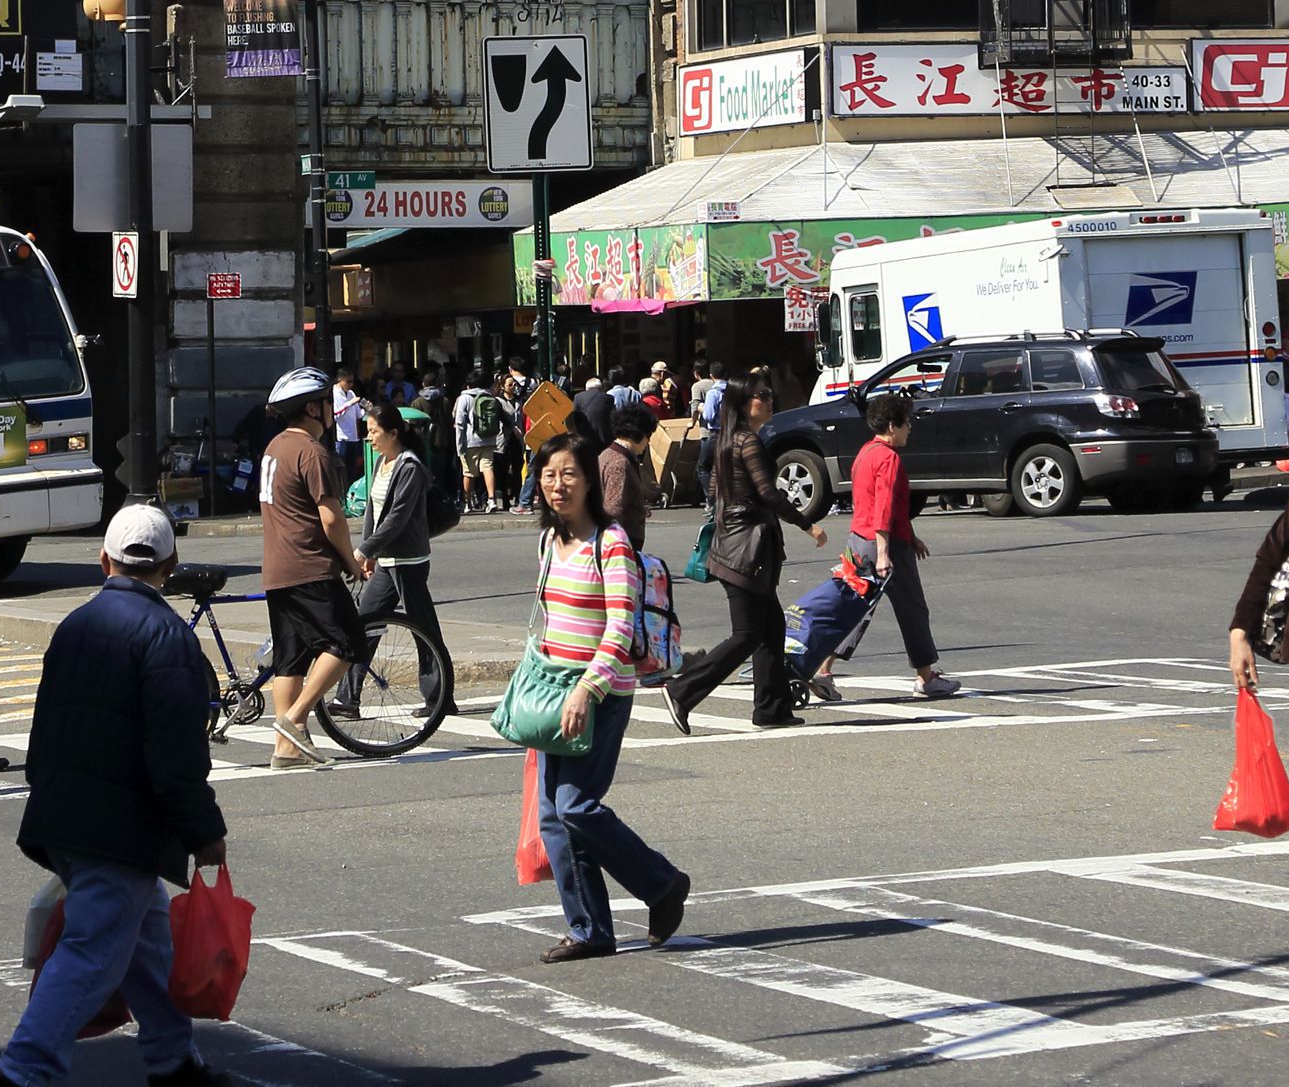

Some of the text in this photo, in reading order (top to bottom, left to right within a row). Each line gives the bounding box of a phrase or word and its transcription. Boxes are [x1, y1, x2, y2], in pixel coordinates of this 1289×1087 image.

[227, 13, 237, 23] TO
[227, 22, 296, 34] BASEBALL SPOKEN
[839, 51, 1125, 113] 長江超市
[1131, 74, 1171, 88] 40-33
[719, 65, 795, 124] Food Market
[1122, 95, 1185, 109] MAIN ST.
[334, 174, 367, 189] 41 AV
[364, 190, 467, 218] 24 HOURS
[481, 202, 509, 213] LOTTERY
[1067, 221, 1118, 233] 4500010
[565, 234, 645, 291] 長江超市
[976, 283, 988, 296] We
[988, 280, 1012, 296] Deliver
[1012, 280, 1024, 294] For
